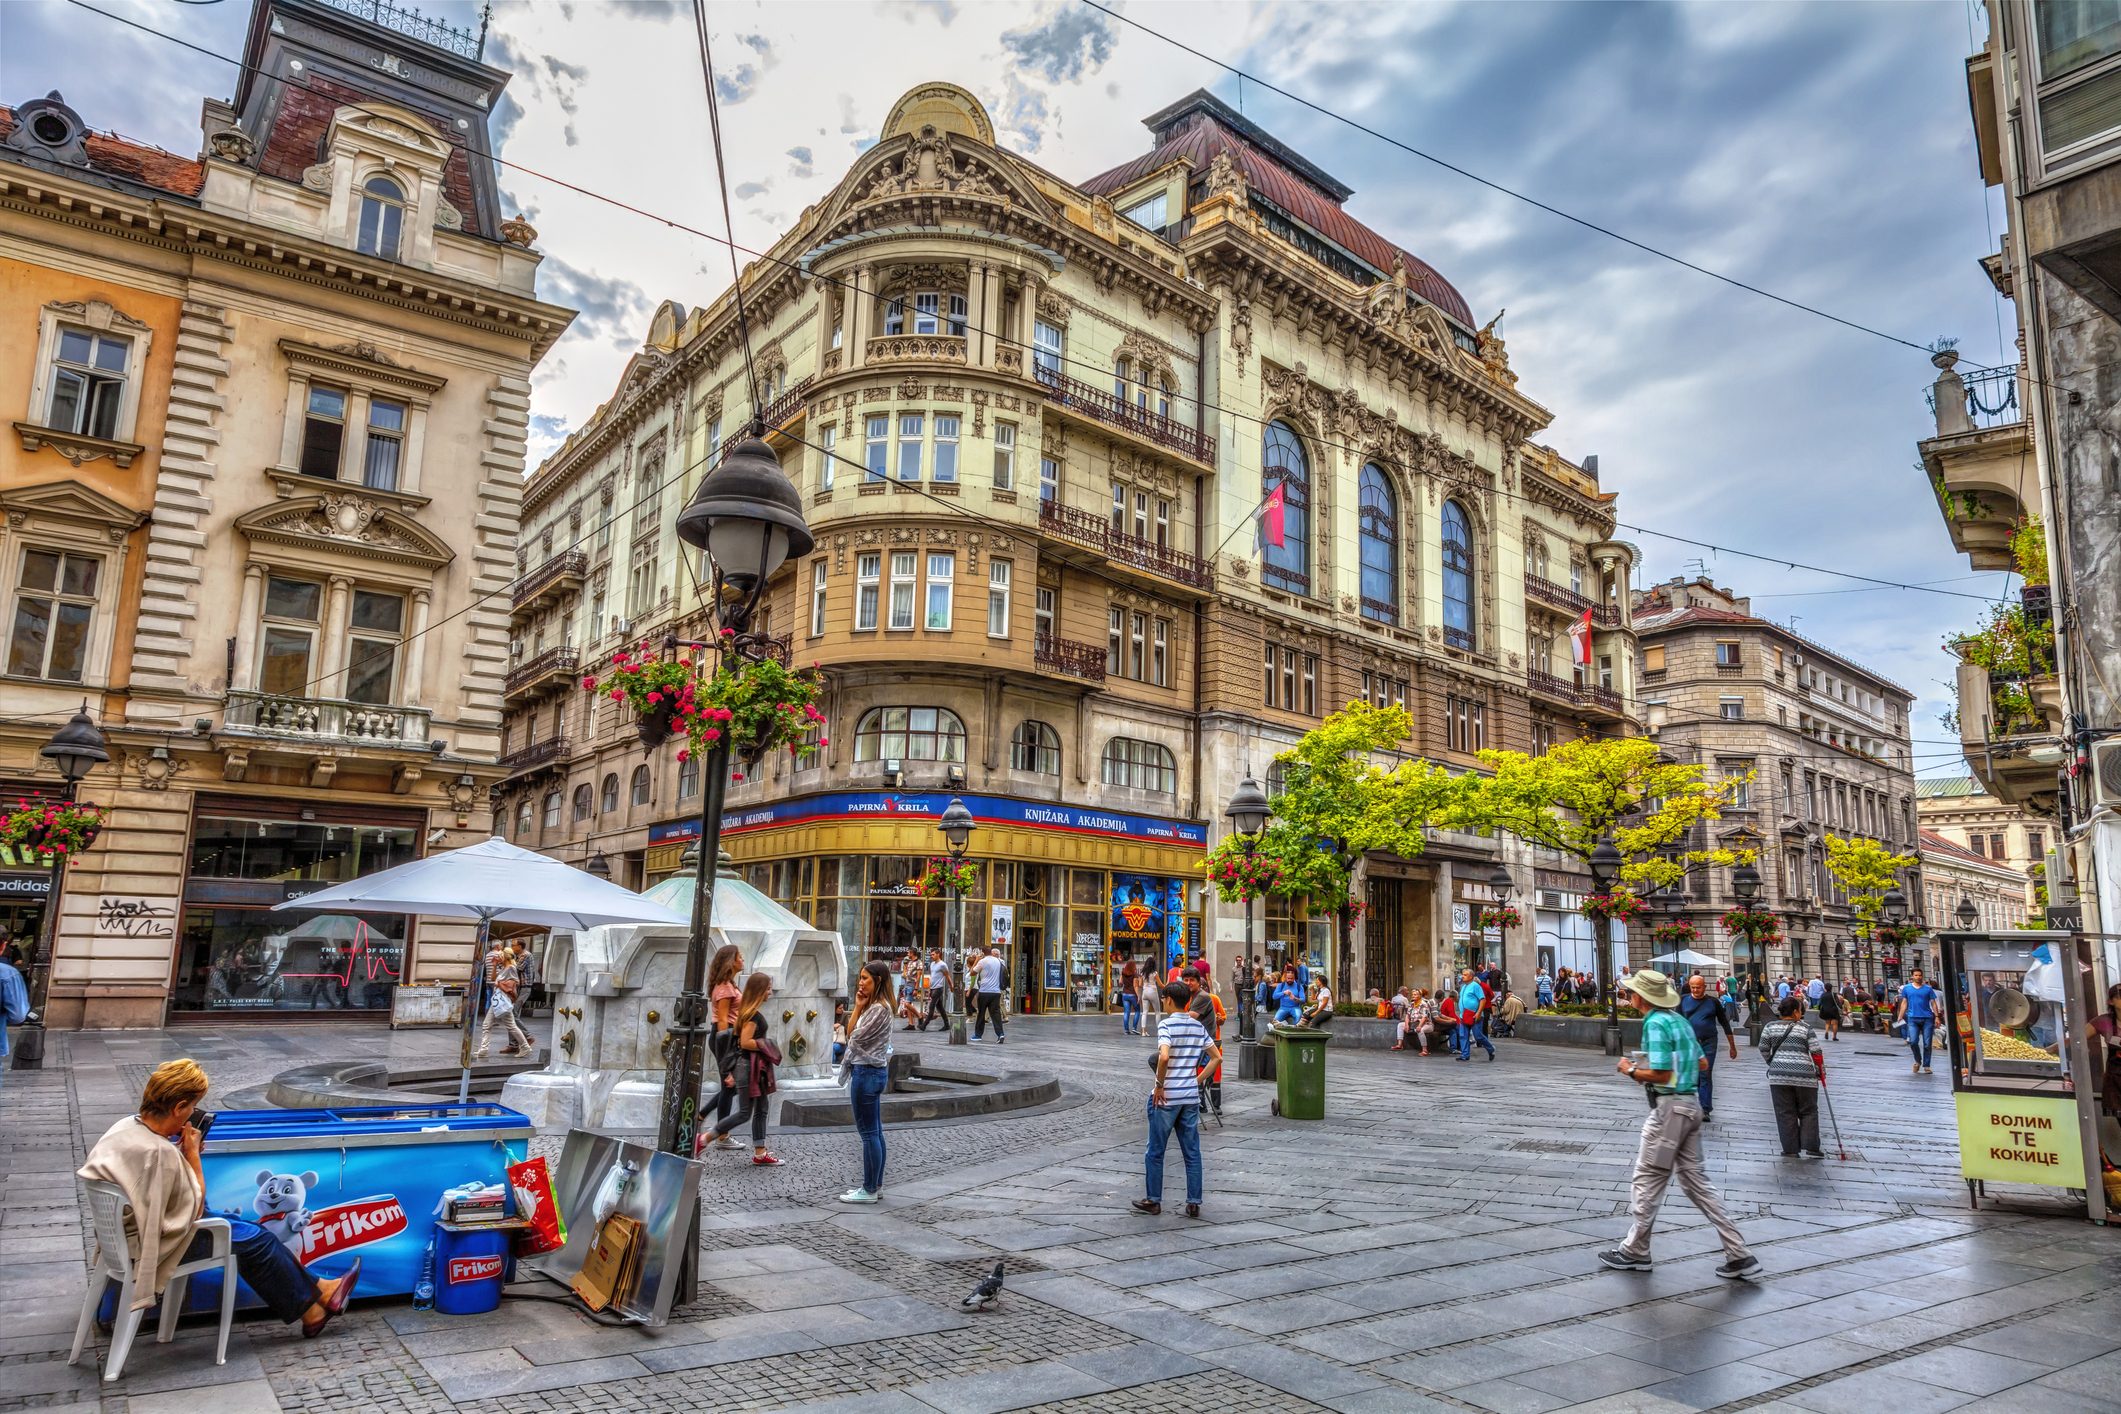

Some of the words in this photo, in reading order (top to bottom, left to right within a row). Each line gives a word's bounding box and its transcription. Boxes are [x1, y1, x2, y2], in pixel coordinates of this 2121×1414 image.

[848, 803, 887, 811] PAPIRNA
[745, 811, 774, 825] AKADEMIJA
[1025, 808, 1070, 824] KNJIŽARA
[1077, 815, 1127, 832] AKADEMIJA
[1147, 827, 1173, 837] PAPIRNA
[1179, 832, 1197, 840] KRILA
[0, 880, 50, 891] adidas
[1990, 1114, 2052, 1129] ВОЛИМ
[2009, 1130, 2036, 1147] ТЕ
[1990, 1147, 2059, 1166] КОКИЦЕ
[302, 1204, 404, 1254] Frikom
[453, 1260, 501, 1277] Frikom
